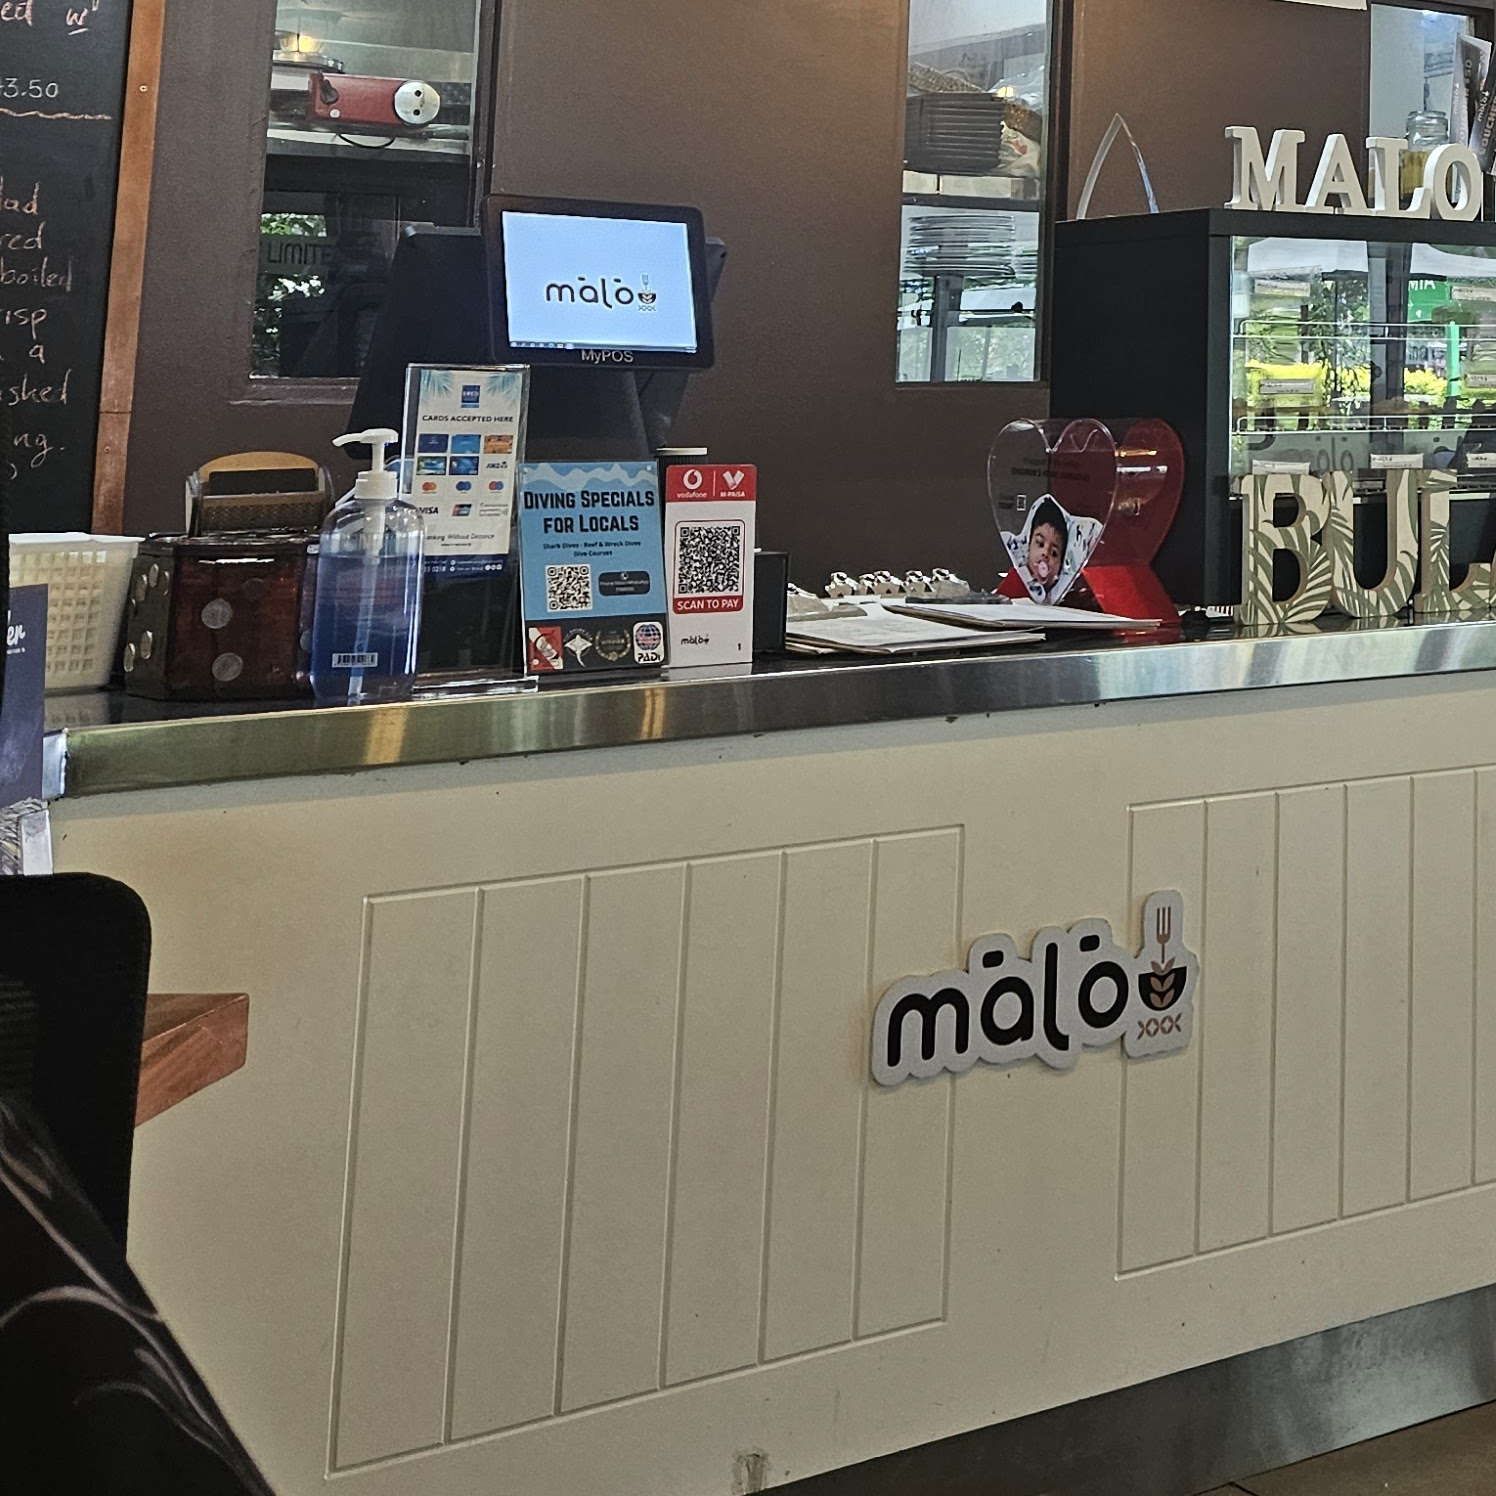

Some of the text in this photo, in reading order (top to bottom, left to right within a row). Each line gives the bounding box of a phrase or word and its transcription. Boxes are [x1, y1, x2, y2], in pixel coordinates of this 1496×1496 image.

[1224, 125, 1482, 222] MALO
[581, 348, 635, 364] MyPOS
[450, 415, 492, 423] ACCEPTED
[676, 491, 707, 499] vodafone
[677, 598, 739, 611] SCAN TO PAY
